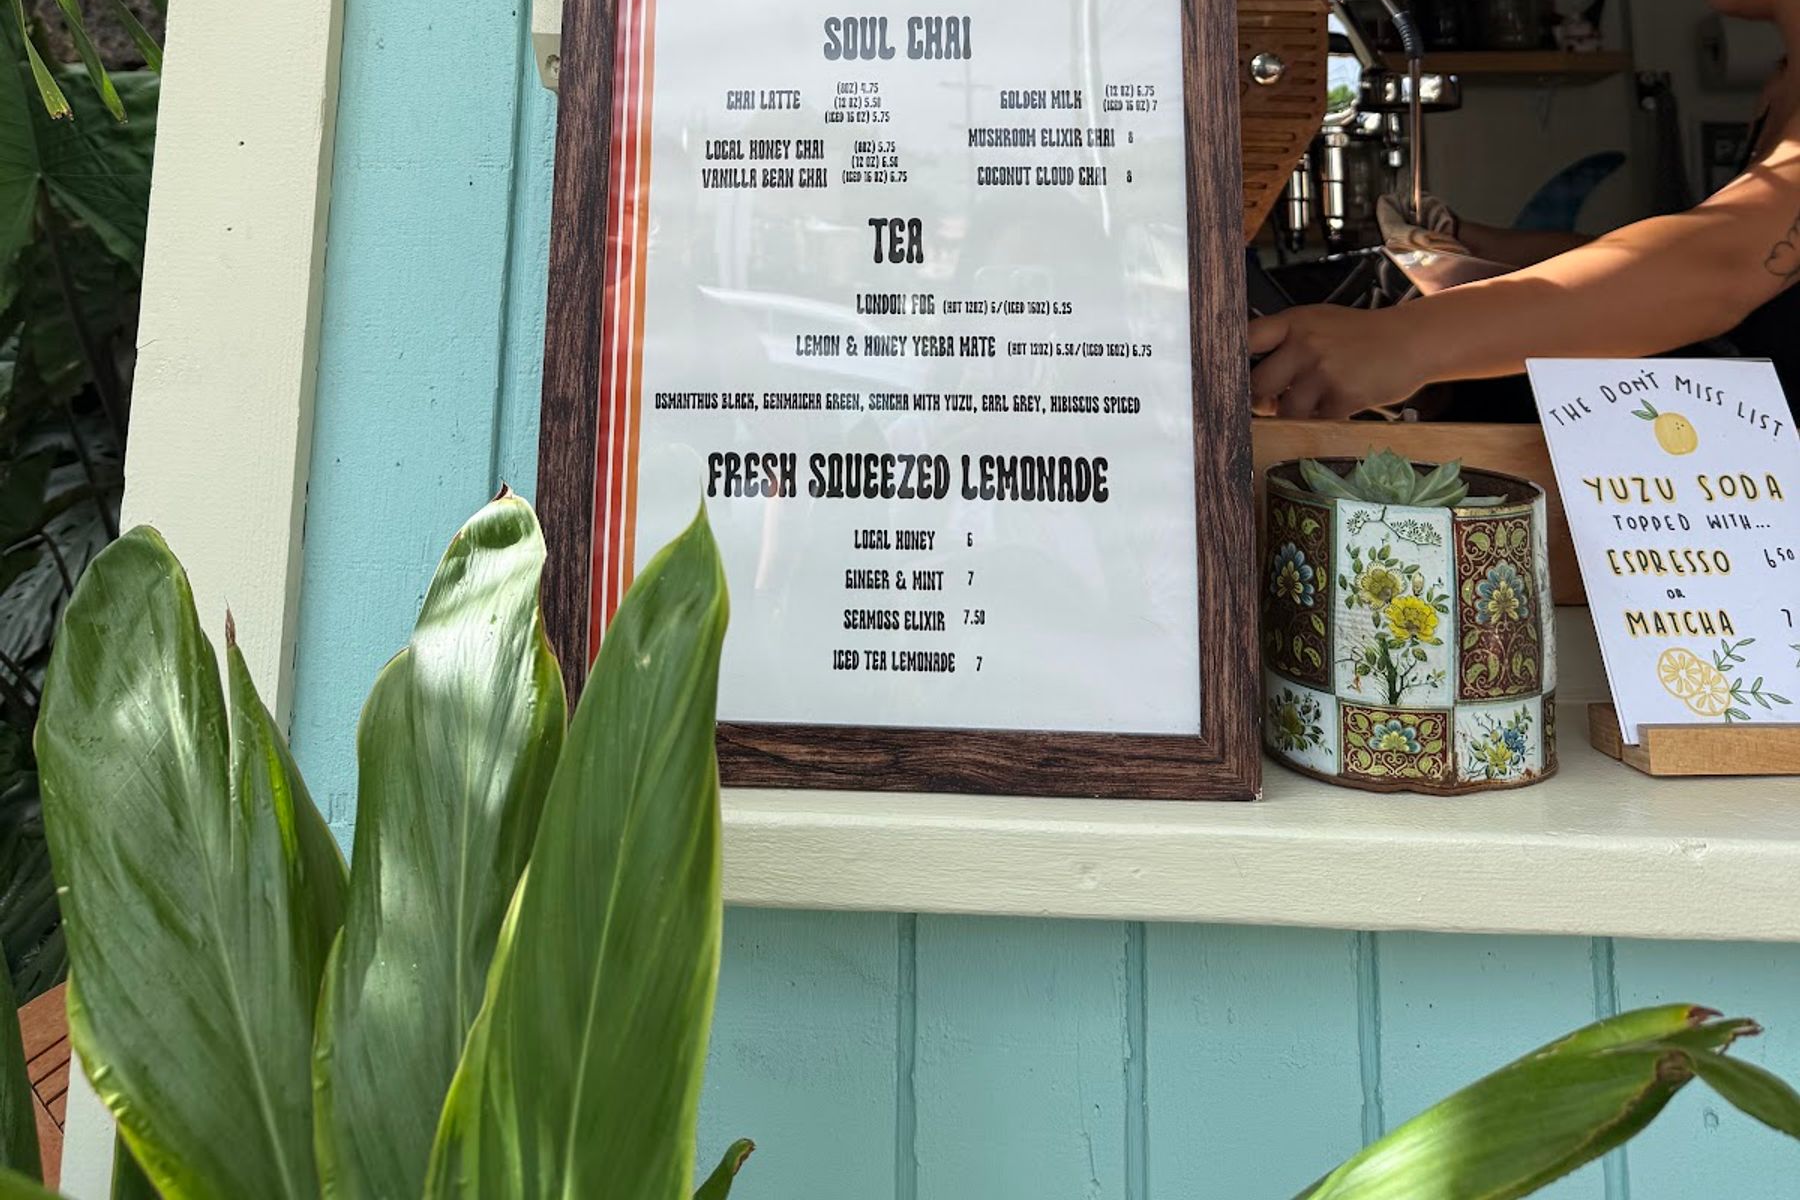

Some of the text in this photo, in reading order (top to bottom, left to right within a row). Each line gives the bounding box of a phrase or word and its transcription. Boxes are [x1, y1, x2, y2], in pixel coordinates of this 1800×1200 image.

[823, 16, 972, 61] SOUL CHAI
[726, 90, 801, 111] CHAI LATTE
[1000, 90, 1082, 109] GOLDEN MILK
[968, 128, 1115, 147] MUSHROOM ELIXIR CHAI
[705, 139, 824, 160] LOCAL HONEY CHAI
[702, 168, 828, 189] VANILLA BEAN CHAI
[977, 166, 1107, 186] COCONUT CLOUD CHAI
[868, 217, 924, 264] TEA
[857, 294, 935, 315] LONDON FOG
[796, 335, 996, 357] LEMON & HONEY YERBA MATE
[655, 392, 718, 410] OSMANTHUS
[825, 393, 864, 412] GREEN,
[868, 393, 909, 411] SENCHA
[913, 394, 940, 411] WITH
[944, 394, 978, 414] YUZU,
[982, 394, 1009, 412] EARL
[1013, 395, 1046, 414] GREY,
[1050, 395, 1100, 414] HIBISCUS
[1103, 396, 1141, 414] SPICED
[1549, 369, 1785, 438] THE DON'T MISS LIST
[707, 451, 1109, 503] FRESH SQUEEZED LEMONADE
[1584, 475, 1784, 502] YUZU SODA
[1613, 514, 1771, 531] TOPPED WITH...
[854, 529, 891, 550] LOCAL
[895, 530, 936, 551] HONEY
[1608, 550, 1730, 574] ESPRESSO
[845, 569, 890, 590] GINGER
[895, 570, 907, 590] &
[912, 570, 944, 591] MINT
[1667, 589, 1685, 599] OR
[843, 609, 900, 630] SEAMOSS
[904, 610, 945, 631] ELIXIR
[1626, 611, 1734, 636] MATCHA
[833, 649, 860, 670] ICED
[864, 650, 887, 671] TEA
[892, 651, 955, 673] LEMONADE
